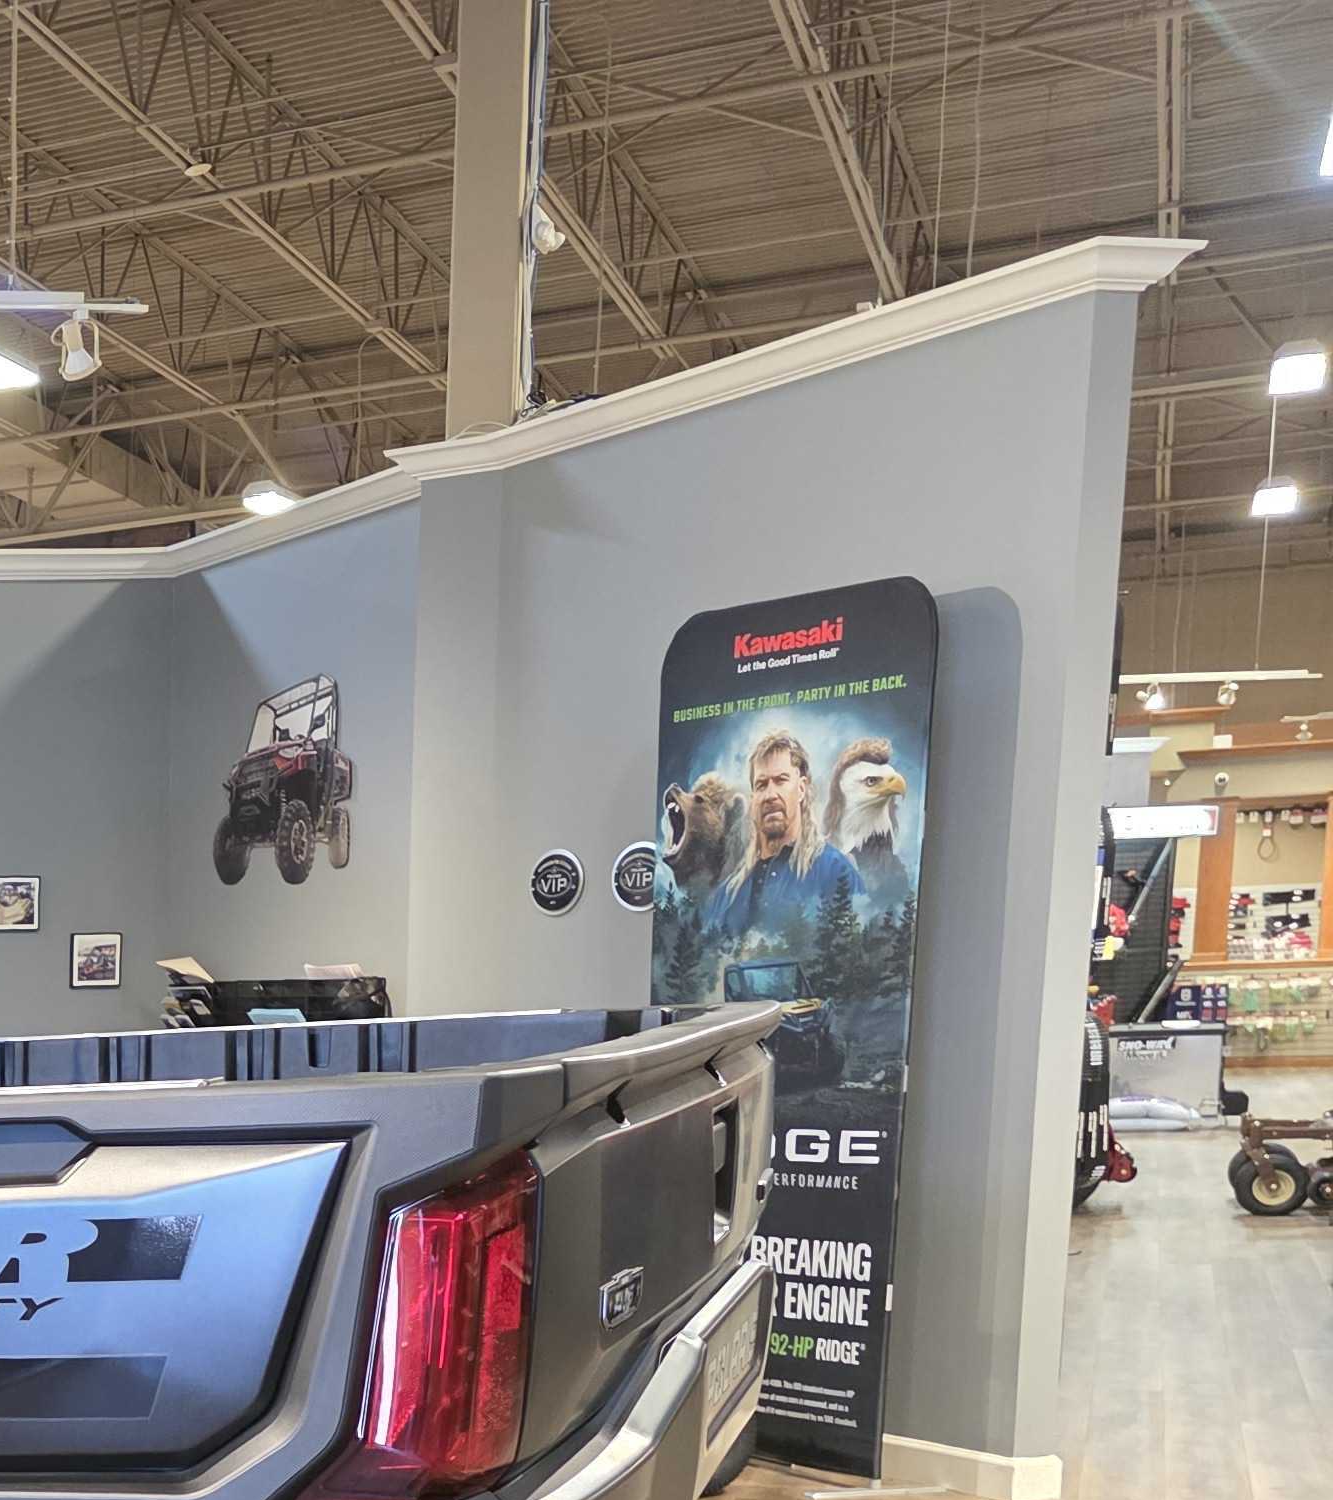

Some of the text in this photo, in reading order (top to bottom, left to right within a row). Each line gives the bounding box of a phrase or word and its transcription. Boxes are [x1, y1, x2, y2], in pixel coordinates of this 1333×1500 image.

[734, 616, 843, 658] Kawasaki
[737, 663, 751, 673] Let
[753, 661, 766, 670] the
[768, 656, 790, 668] Good
[792, 652, 817, 664] Times
[673, 703, 721, 723] BUSINESS
[723, 701, 734, 715] IN
[736, 698, 755, 712] THE
[796, 686, 831, 703] PARTY
[834, 684, 846, 698] IN
[849, 680, 870, 695] THE
[872, 674, 907, 692] BACK.
[541, 877, 568, 893] VIP
[624, 872, 653, 888] VIP
[771, 1128, 881, 1165] GE
[751, 1235, 872, 1281] BREAKING
[784, 1281, 871, 1327] ENGINE
[770, 1333, 814, 1359] 92-HP
